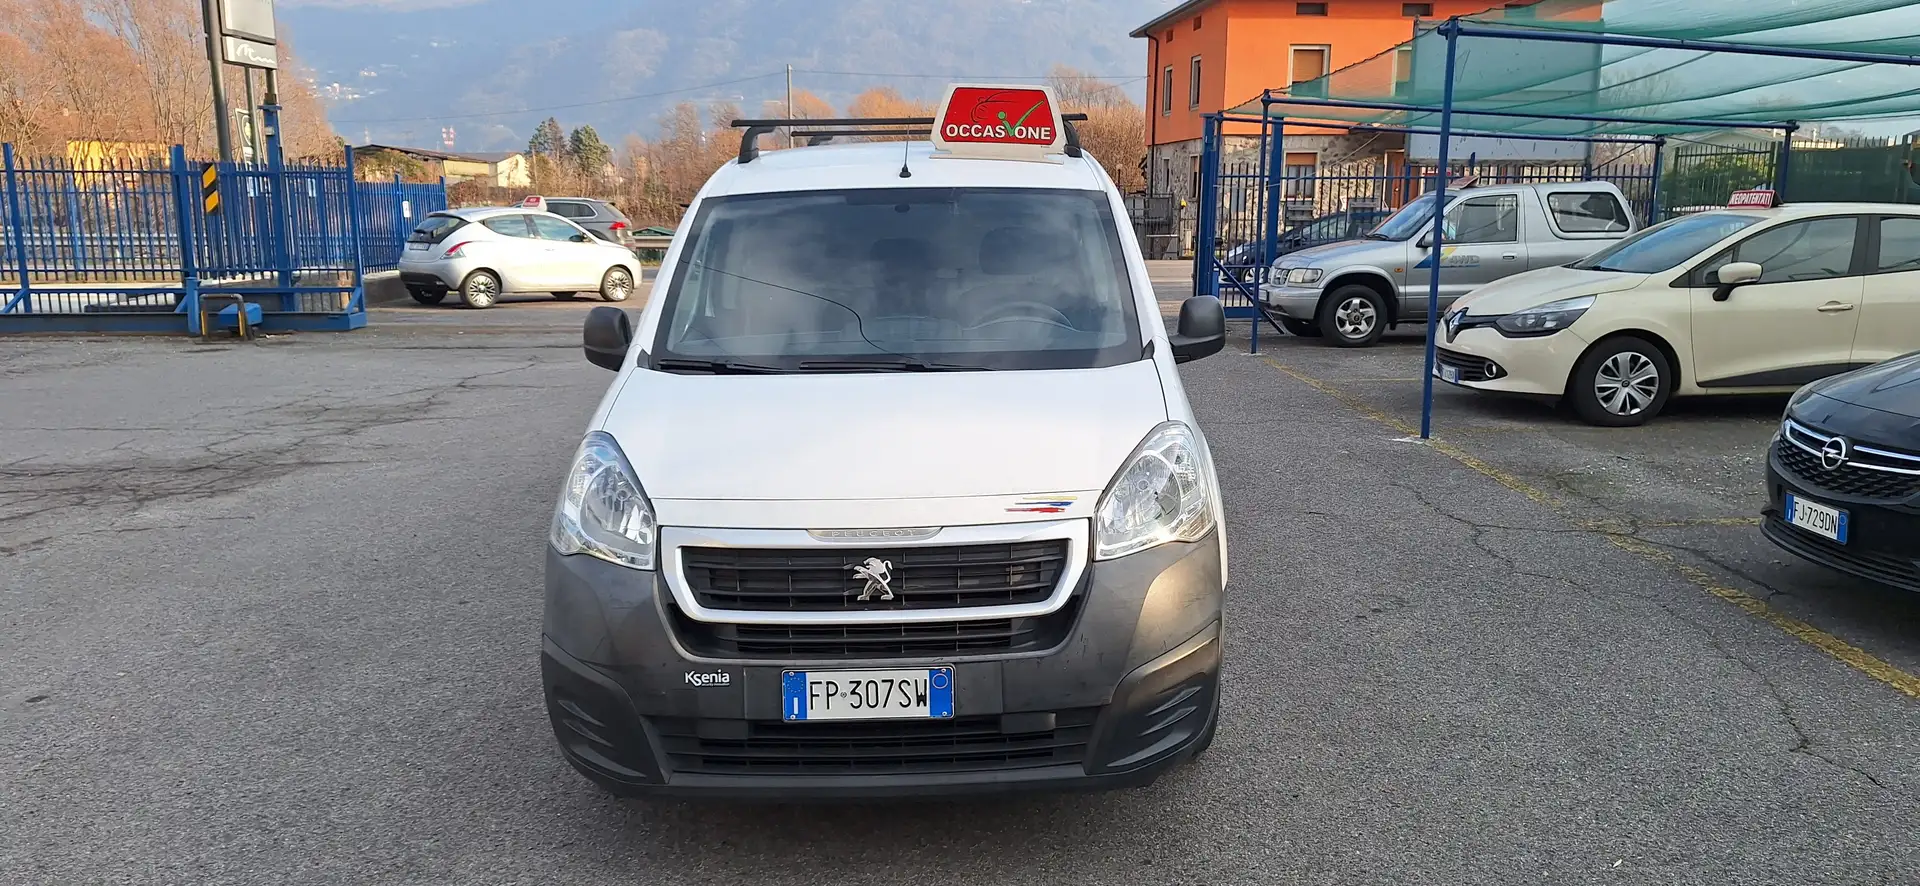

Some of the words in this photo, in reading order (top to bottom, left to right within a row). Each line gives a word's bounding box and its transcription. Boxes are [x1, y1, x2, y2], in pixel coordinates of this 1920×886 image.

[1729, 192, 1771, 204] NEOPATENTATI
[1448, 255, 1480, 264] 4WD
[685, 669, 730, 686] Ksenia
